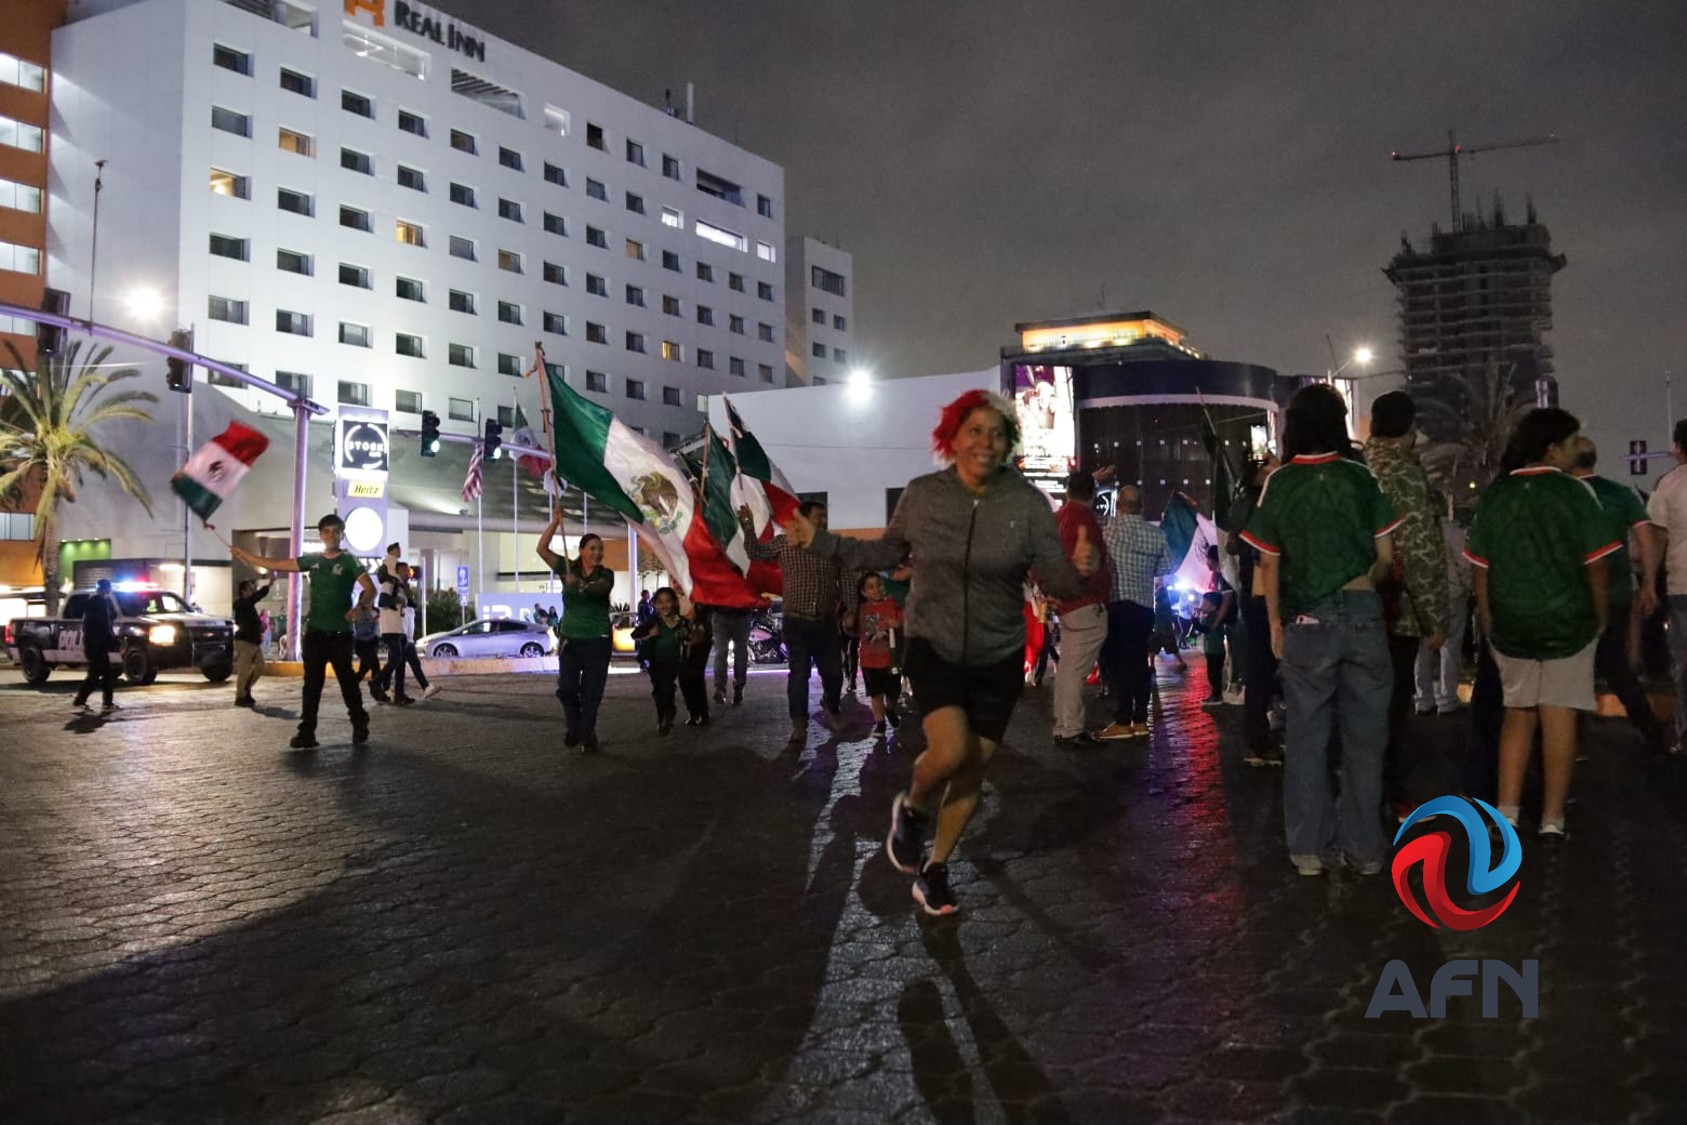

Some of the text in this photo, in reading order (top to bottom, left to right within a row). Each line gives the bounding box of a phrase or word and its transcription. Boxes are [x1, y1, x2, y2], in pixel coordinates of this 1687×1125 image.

[394, 0, 485, 62] REAL INN
[354, 485, 379, 494] Hertz
[58, 629, 85, 650] POLI
